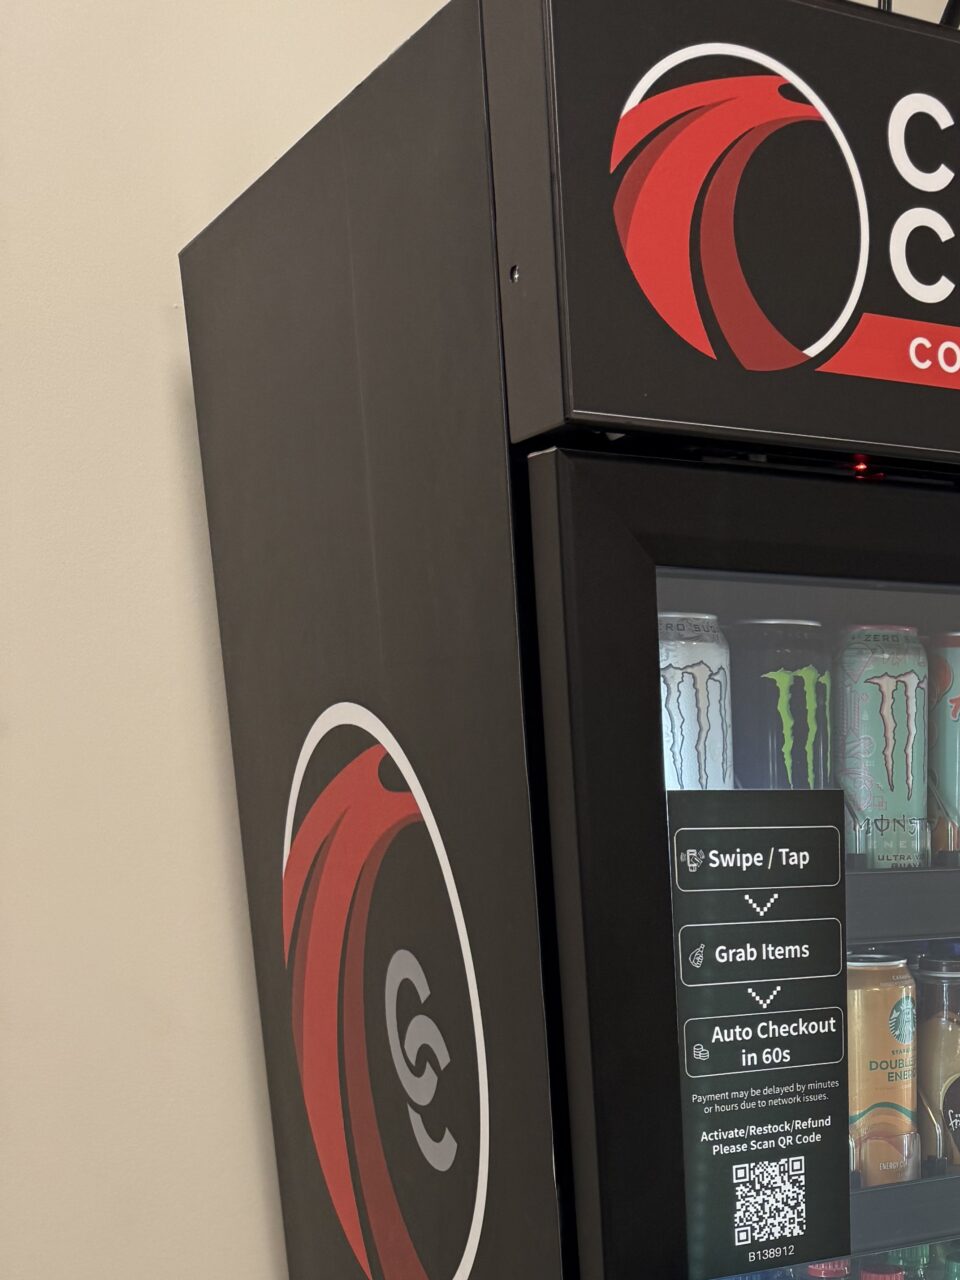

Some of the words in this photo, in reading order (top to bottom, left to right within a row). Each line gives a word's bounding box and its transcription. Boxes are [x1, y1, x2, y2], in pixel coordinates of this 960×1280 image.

[709, 848, 763, 871] Swipe
[767, 847, 774, 870] /
[778, 848, 810, 869] Tap
[715, 943, 757, 963] Grab
[761, 943, 810, 960] Items
[711, 1025, 753, 1043] Auto
[757, 1016, 836, 1041] Checkout
[741, 1049, 757, 1066] in
[762, 1047, 791, 1064] 60s
[692, 1091, 729, 1105] Payment
[731, 1089, 749, 1101] may
[750, 1087, 761, 1097] be
[762, 1084, 795, 1097] delayed
[796, 1082, 806, 1093] by
[807, 1079, 839, 1090] minutes
[703, 1105, 713, 1114] or
[715, 1102, 739, 1113] hours
[740, 1100, 756, 1110] due
[757, 1099, 767, 1108] to
[768, 1095, 801, 1107] network
[802, 1092, 829, 1103] issues.
[700, 1115, 832, 1142] Activate/Restock/Refund
[712, 1141, 747, 1156] Please
[750, 1137, 775, 1151] Scan
[778, 1135, 794, 1149] QR
[795, 1132, 822, 1145] Code
[748, 1245, 795, 1262] B138912
